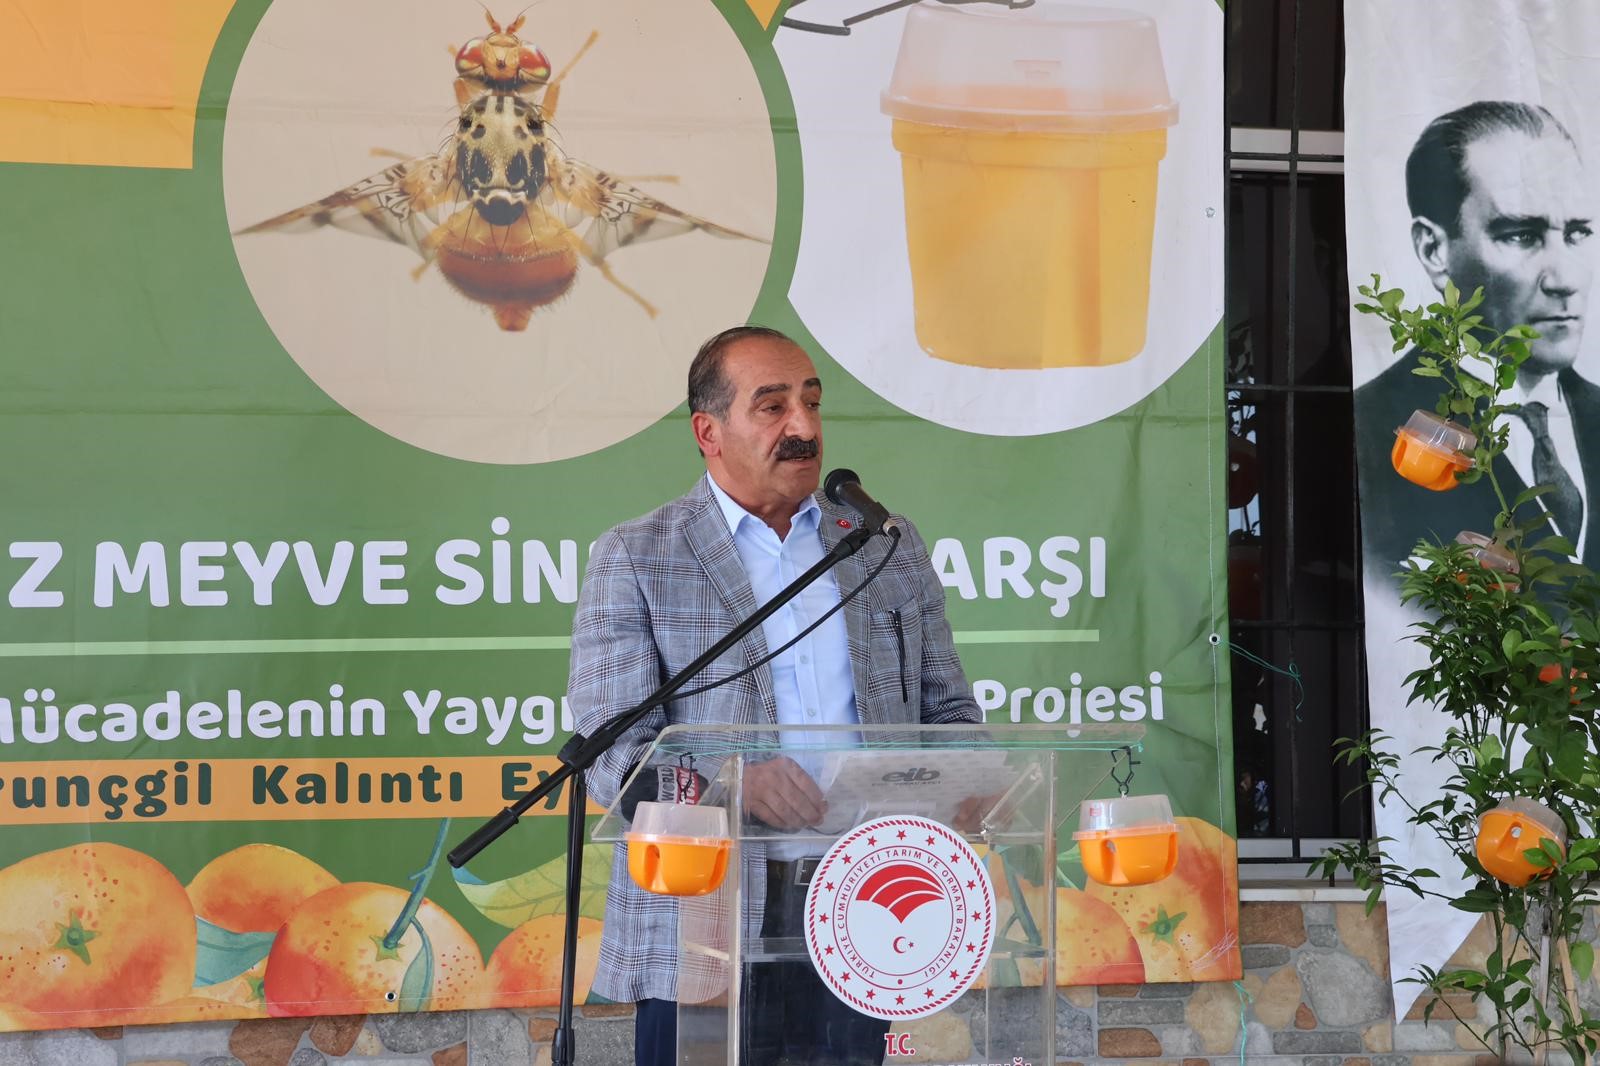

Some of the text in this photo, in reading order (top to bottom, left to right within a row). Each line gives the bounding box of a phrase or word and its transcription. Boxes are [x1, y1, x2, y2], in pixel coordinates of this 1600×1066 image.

[9, 517, 1106, 618] Z MEYVE SİN ARŞI
[973, 671, 1164, 738] Projesi
[0, 761, 212, 820] unçgil
[252, 762, 463, 805] Kalıntı
[886, 849, 922, 860] TARIM
[927, 857, 940, 869] VE
[942, 869, 964, 911] ORMAN
[885, 1033, 916, 1056] T.C.
